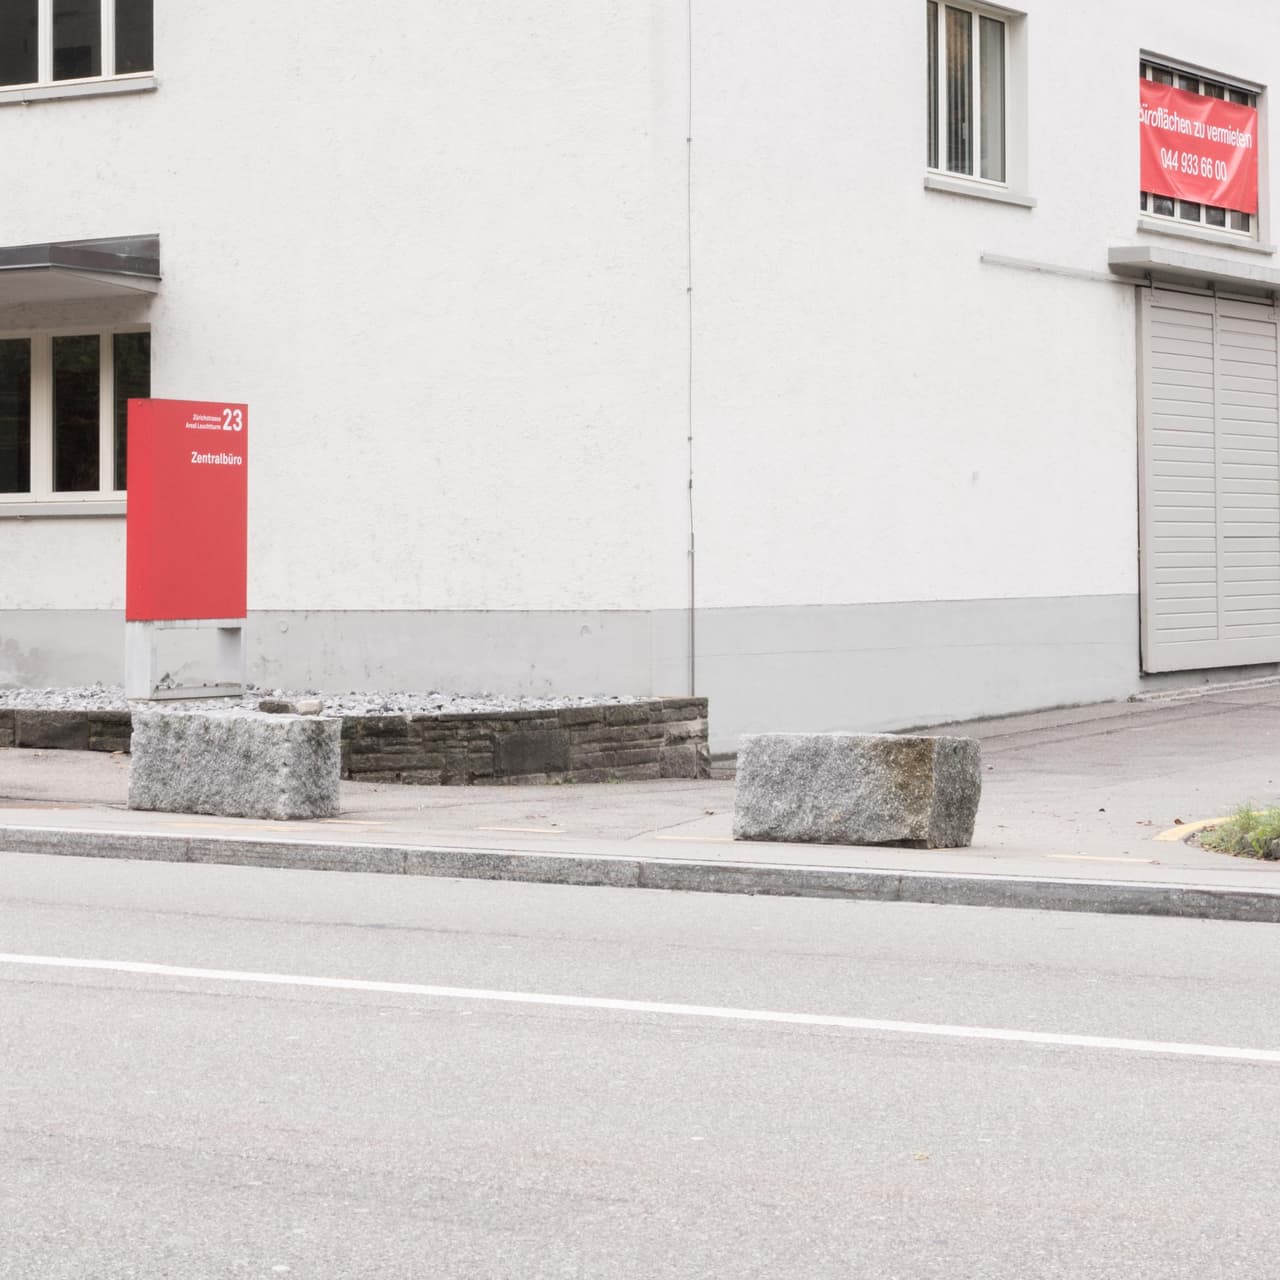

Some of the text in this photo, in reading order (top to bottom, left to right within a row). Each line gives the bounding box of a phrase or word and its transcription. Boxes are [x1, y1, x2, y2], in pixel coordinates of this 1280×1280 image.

[1193, 121, 1205, 139] zu
[1160, 147, 1227, 182] 044 933 66 00
[223, 408, 243, 431] 23
[191, 451, 242, 465] Zentralbüro
